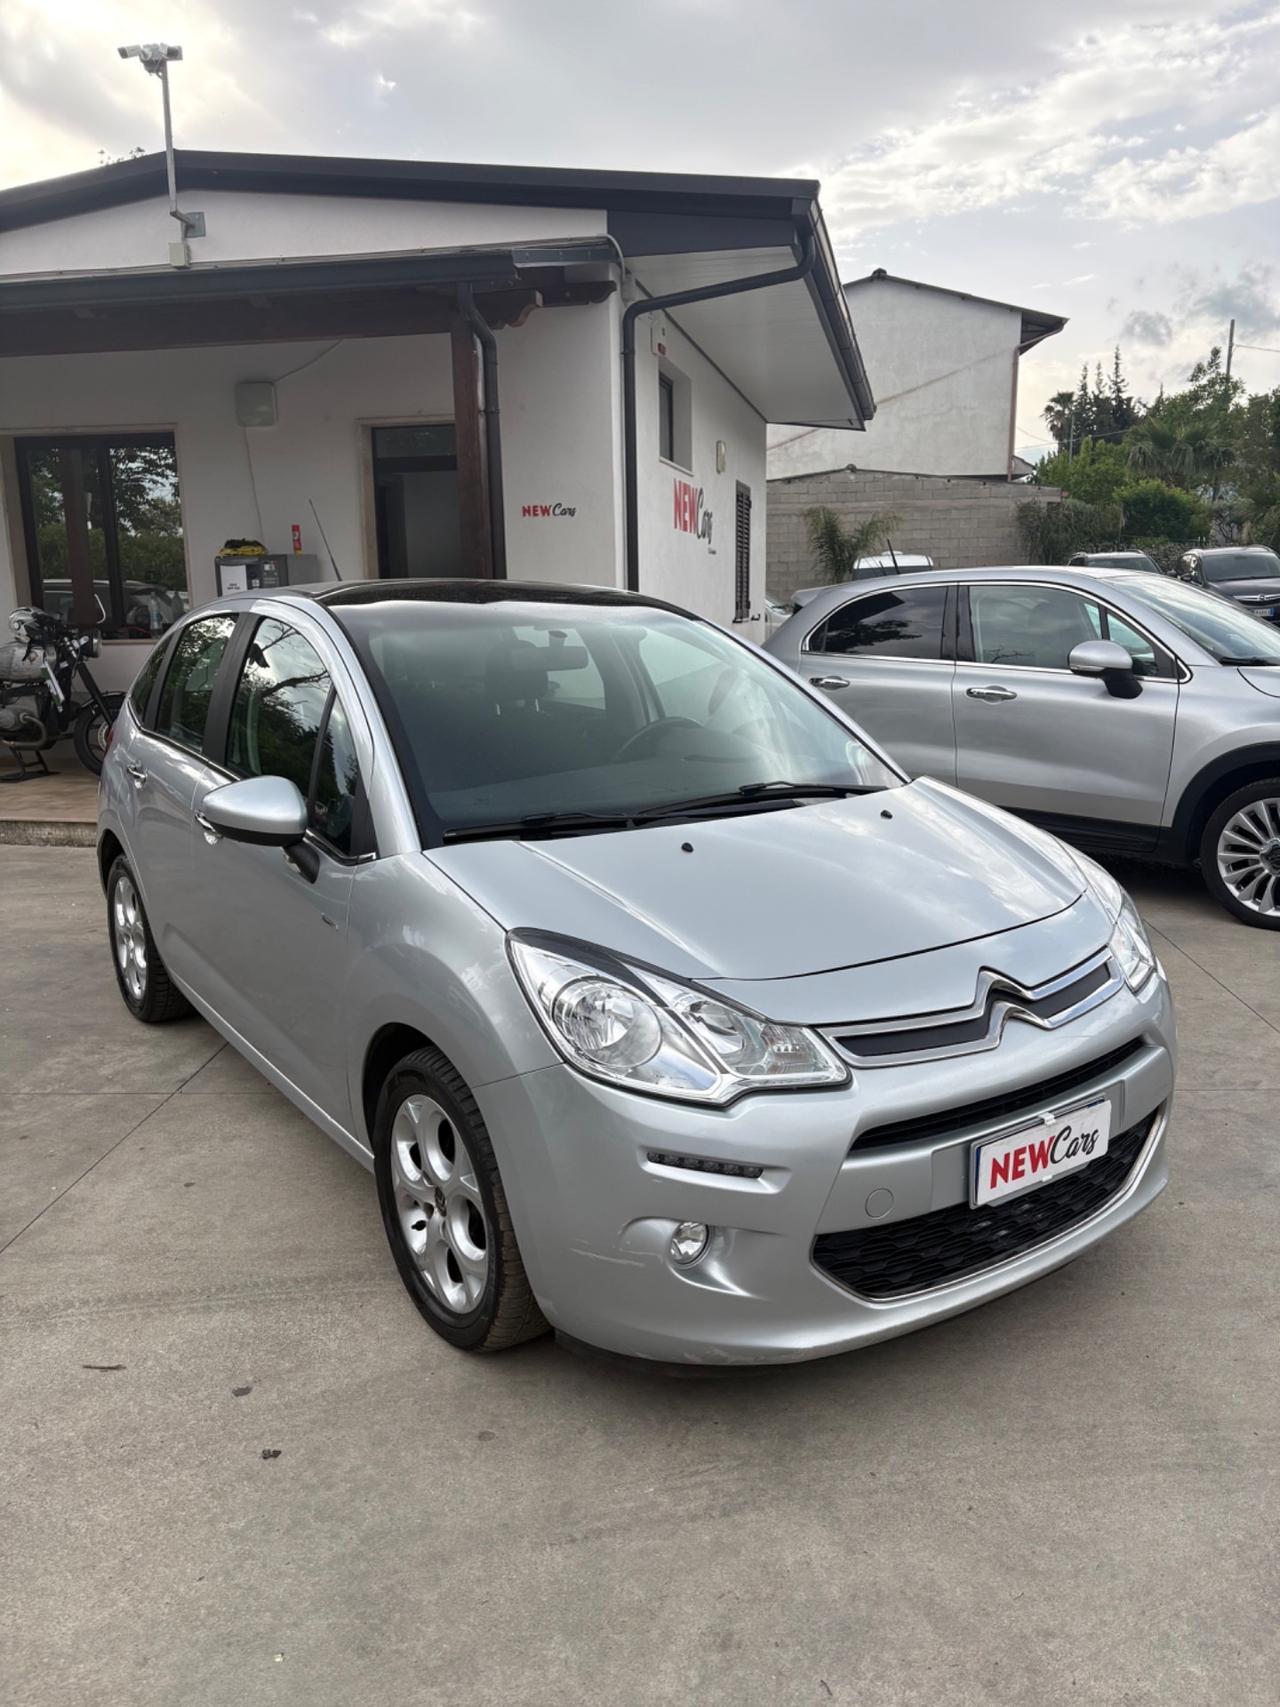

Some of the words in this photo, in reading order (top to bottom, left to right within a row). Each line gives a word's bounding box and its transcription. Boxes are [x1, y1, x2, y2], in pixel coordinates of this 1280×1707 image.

[522, 504, 551, 517] NEW
[991, 1136, 1056, 1189] NEW
[1050, 1125, 1099, 1164] Cars
